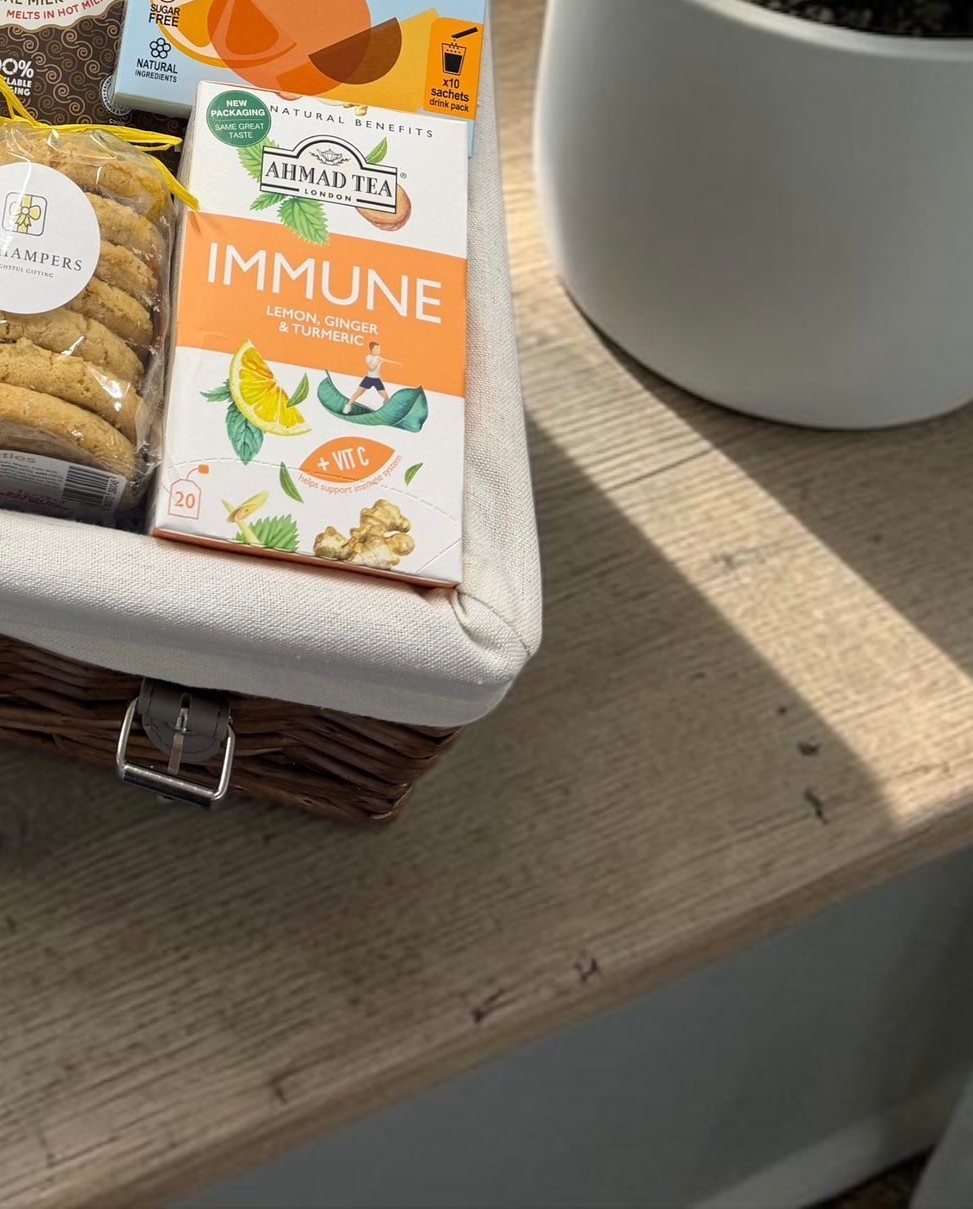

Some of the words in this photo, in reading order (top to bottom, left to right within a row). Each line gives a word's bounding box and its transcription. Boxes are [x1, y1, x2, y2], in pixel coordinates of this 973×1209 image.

[6, 9, 40, 20] MELTS
[43, 10, 55, 19] IN
[57, 5, 79, 16] HOT
[150, 3, 180, 17] SUGAR
[148, 13, 179, 28] FREE
[136, 58, 178, 75] NATURAL
[134, 70, 178, 84] INGREDIENTS
[442, 78, 460, 89] x10
[226, 99, 247, 108] NEW
[431, 88, 470, 104] sachets
[211, 108, 266, 118] PACKAGING
[429, 97, 447, 110] drink
[449, 100, 469, 113] pack
[215, 123, 237, 131] SAME
[270, 104, 345, 125] NATURAL
[355, 118, 434, 138] BENEFITS
[265, 161, 347, 189] AHMAD
[352, 173, 393, 198] TEA
[304, 188, 352, 202] LONDON
[26, 268, 54, 278] GIFTING
[207, 242, 442, 324] IMMUNE
[266, 304, 321, 326] LEMON,
[324, 315, 378, 335] GINGER
[278, 322, 288, 333] &
[292, 323, 364, 346] TURMERIC
[332, 449, 354, 472] VIT
[357, 446, 370, 465] C
[298, 473, 320, 490] helps
[321, 484, 353, 496] support
[354, 471, 385, 492] immune
[383, 454, 403, 477] system
[173, 490, 196, 510] 20
